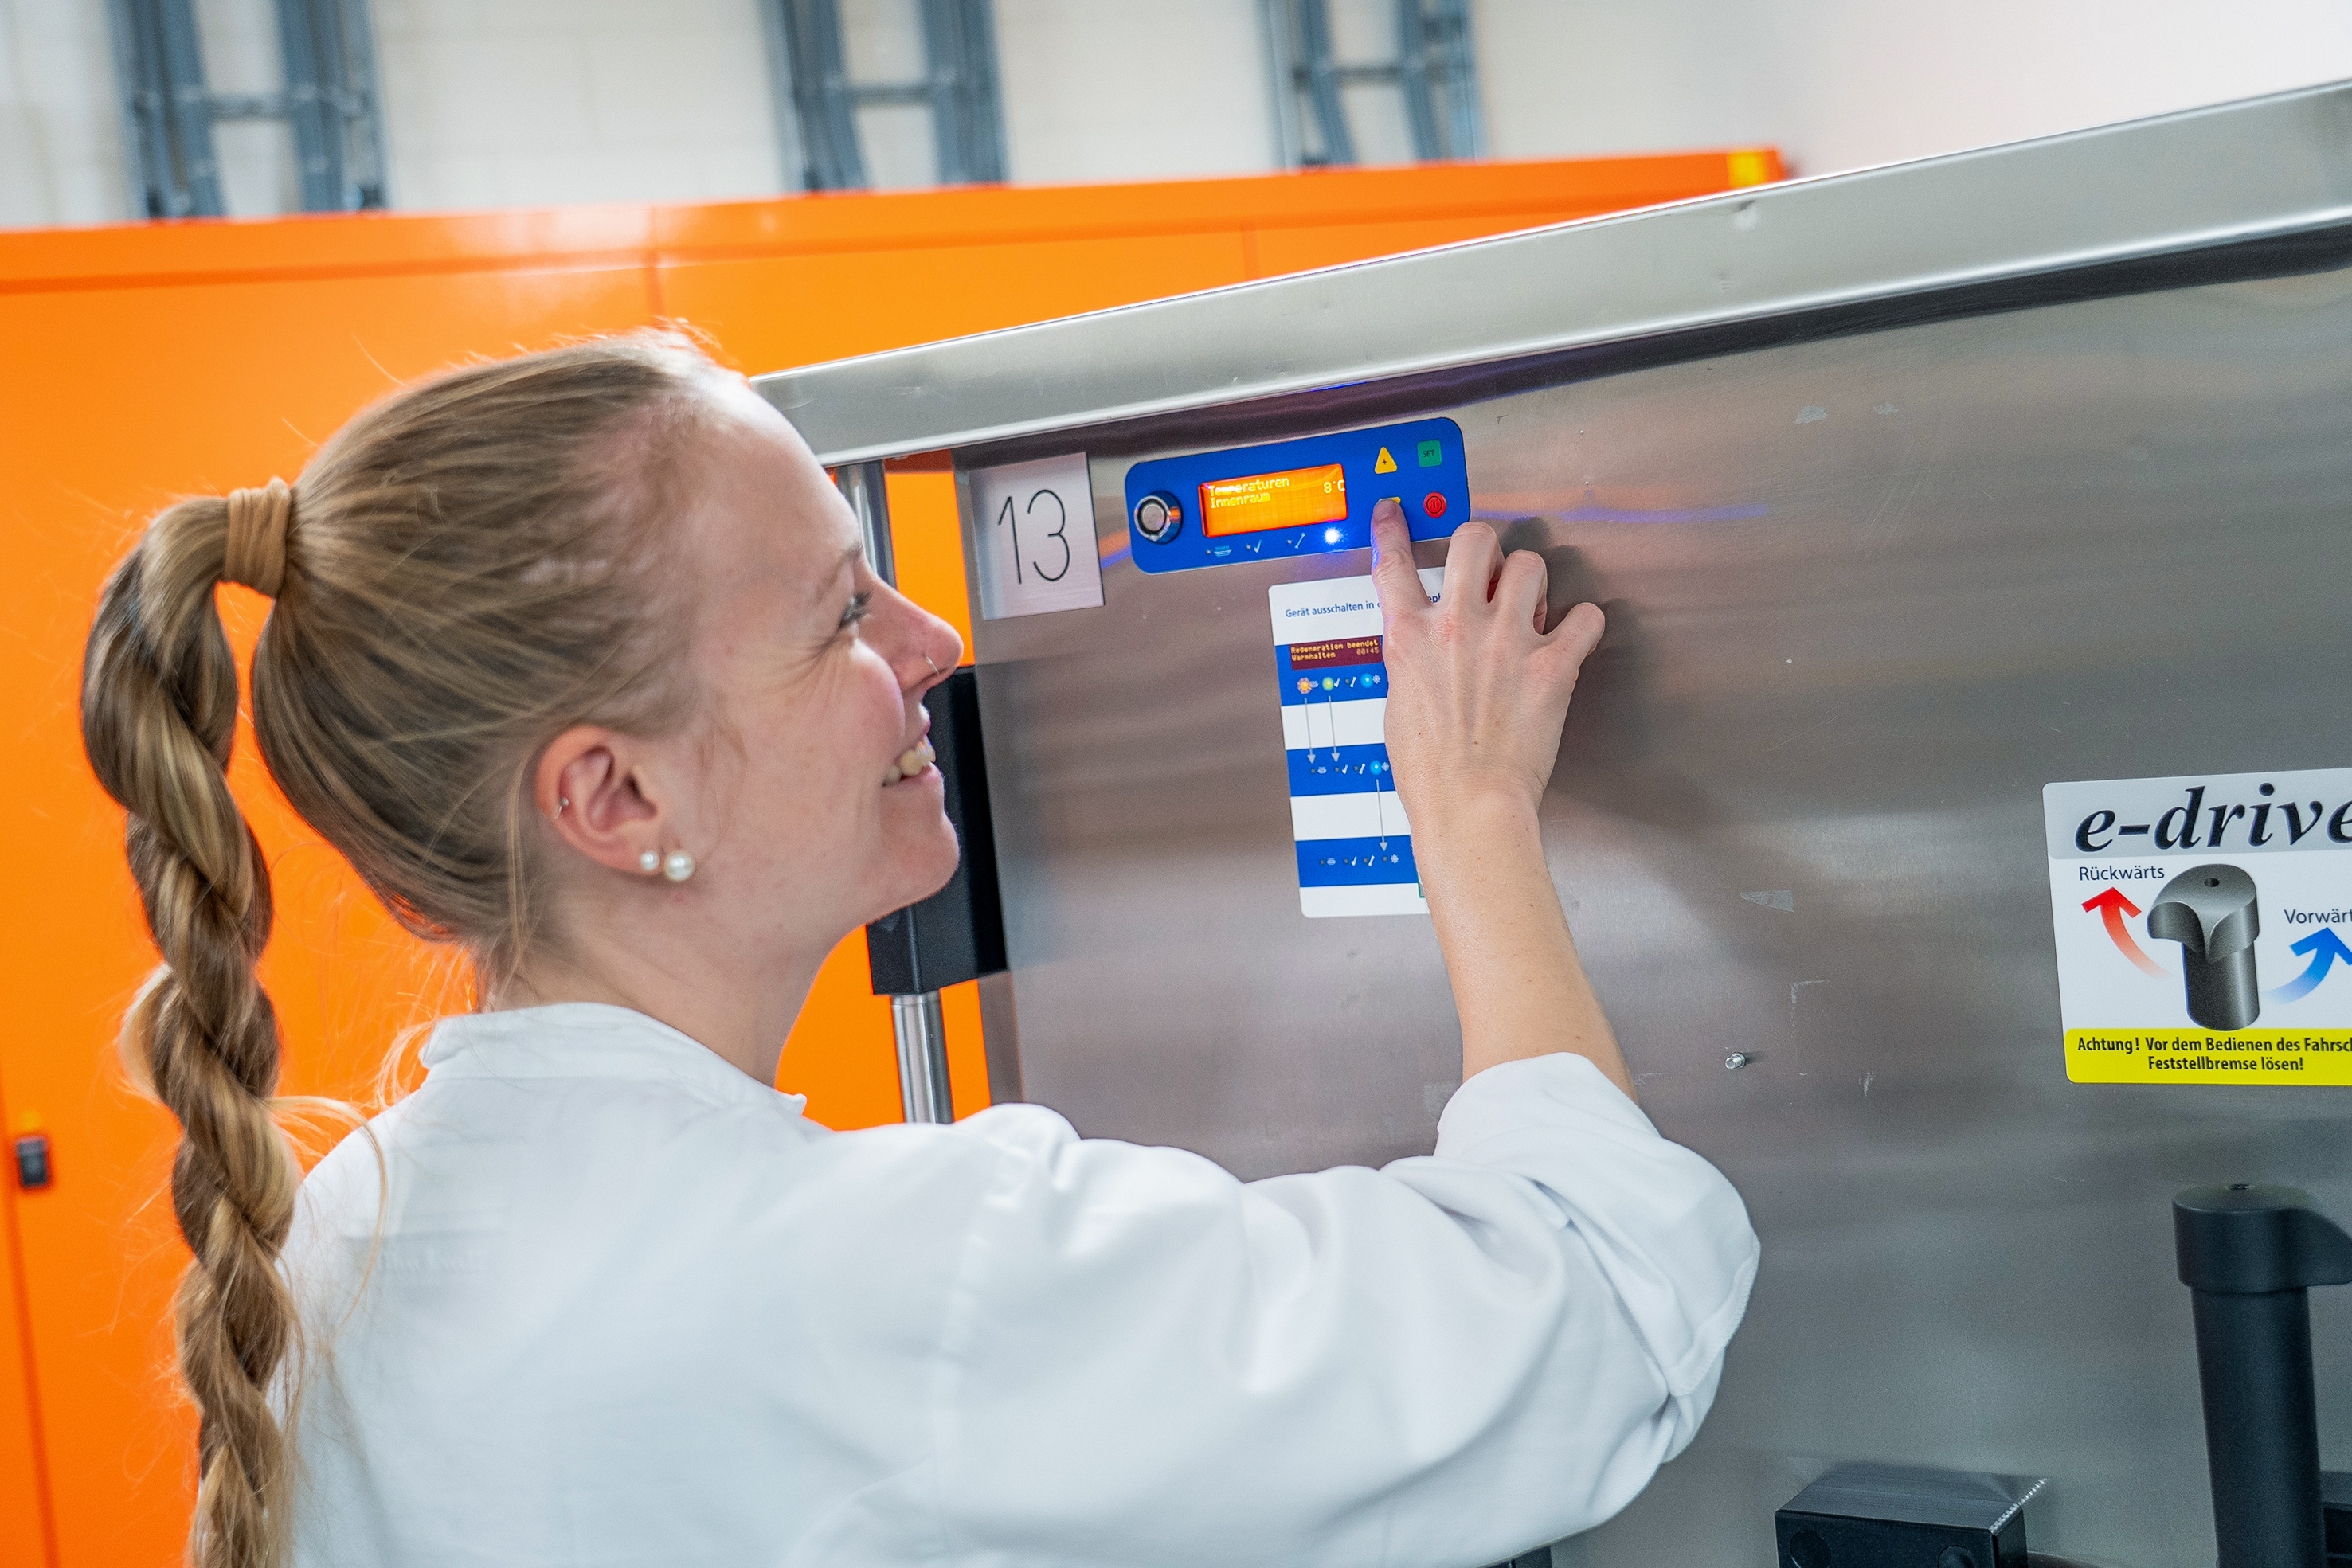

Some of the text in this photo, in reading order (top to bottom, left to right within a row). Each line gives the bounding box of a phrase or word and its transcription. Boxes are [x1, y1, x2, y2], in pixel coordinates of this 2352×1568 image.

[1423, 449, 1435, 458] SET
[1209, 477, 1290, 497] Temperaturen
[1210, 491, 1271, 509] Innenraum
[998, 489, 1070, 585] 13
[1285, 607, 1309, 618] Gerät
[1312, 601, 1364, 616] ausschalten
[1365, 600, 1375, 610] in
[1290, 639, 1379, 654] Regeneration beendet
[1291, 651, 1336, 662] Warmhalten
[2074, 782, 2352, 853] e-drive
[2079, 865, 2165, 882] Rückwärts
[2145, 1037, 2169, 1051] Vor
[2172, 1036, 2202, 1051] dem
[2205, 1037, 2272, 1052] Bedienen
[2276, 1037, 2300, 1052] des
[2148, 1055, 2303, 1071] Feststellbremse lösen!
